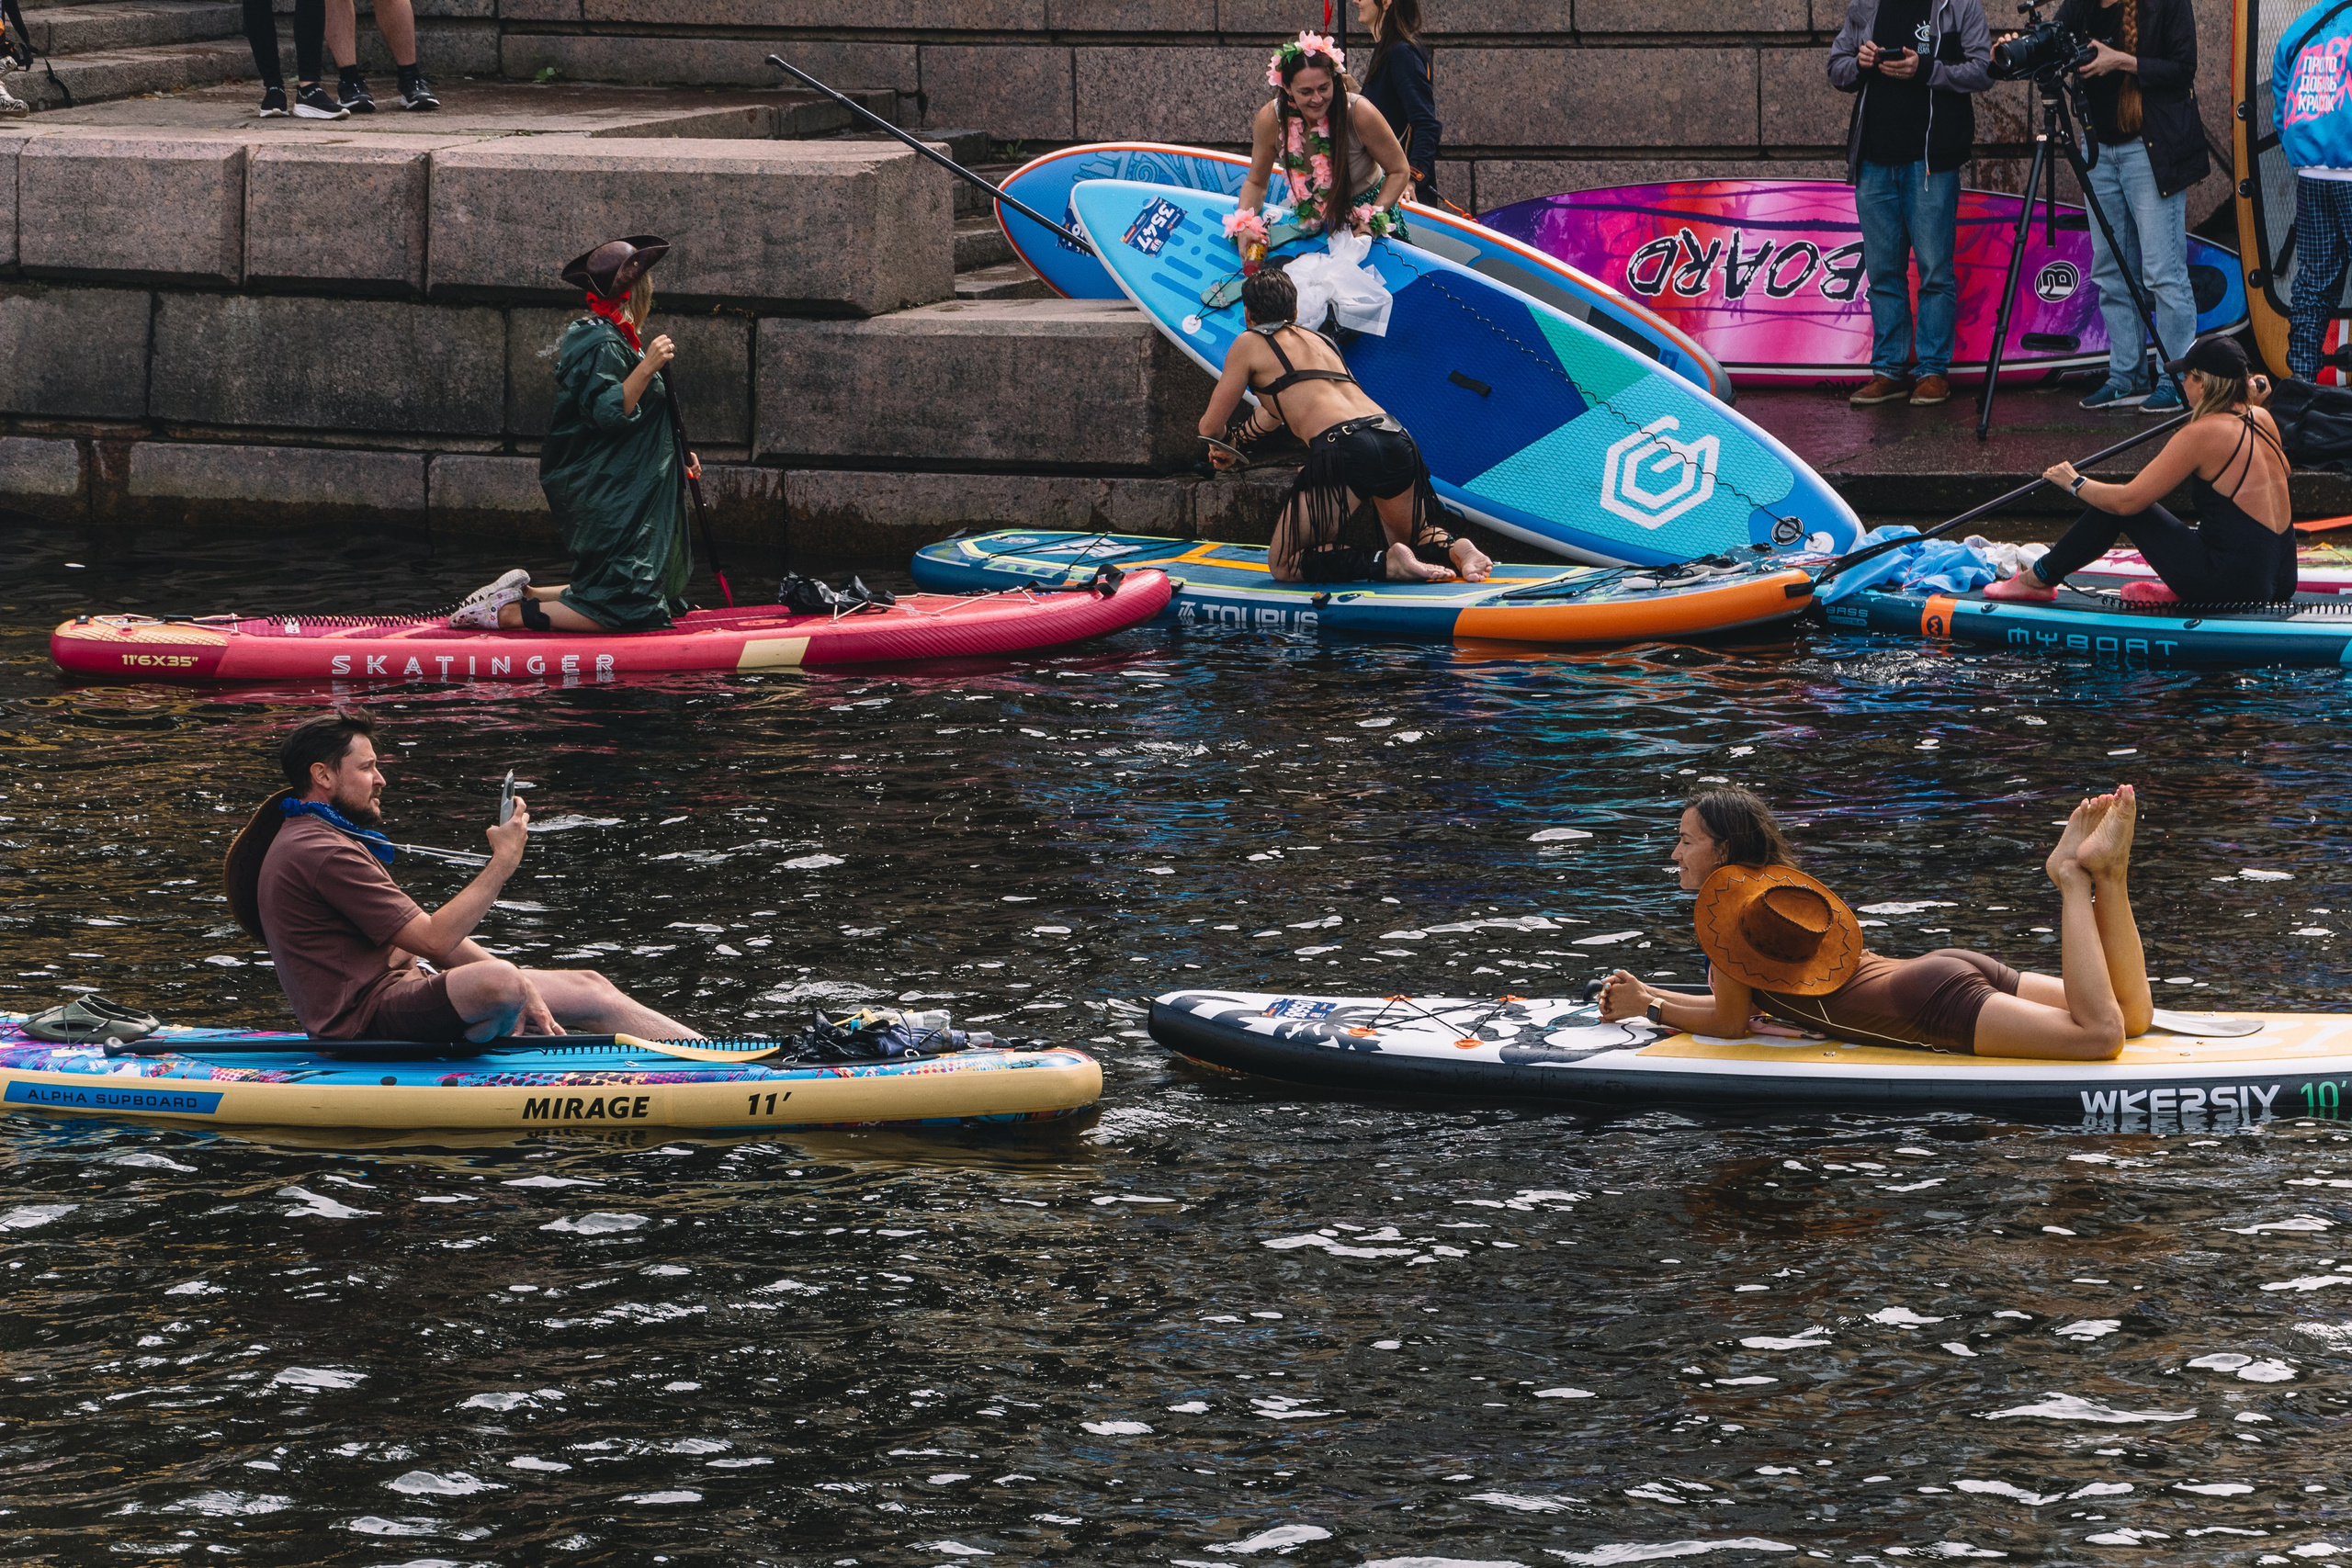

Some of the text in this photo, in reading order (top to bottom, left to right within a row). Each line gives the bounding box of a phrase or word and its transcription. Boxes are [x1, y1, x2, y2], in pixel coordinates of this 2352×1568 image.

[2299, 74, 2336, 94] ДОБАВЬ
[2298, 94, 2335, 112] КРАСОК
[1136, 203, 1175, 250] 3547
[1626, 227, 1870, 303] BOARD
[1826, 606, 1869, 617] BASS
[1829, 617, 1866, 626] HUNTER
[332, 654, 615, 675] SKATINGER
[28, 1089, 198, 1108] ALPHA SUPBOARD
[521, 1091, 792, 1120] MIRAGE 11'
